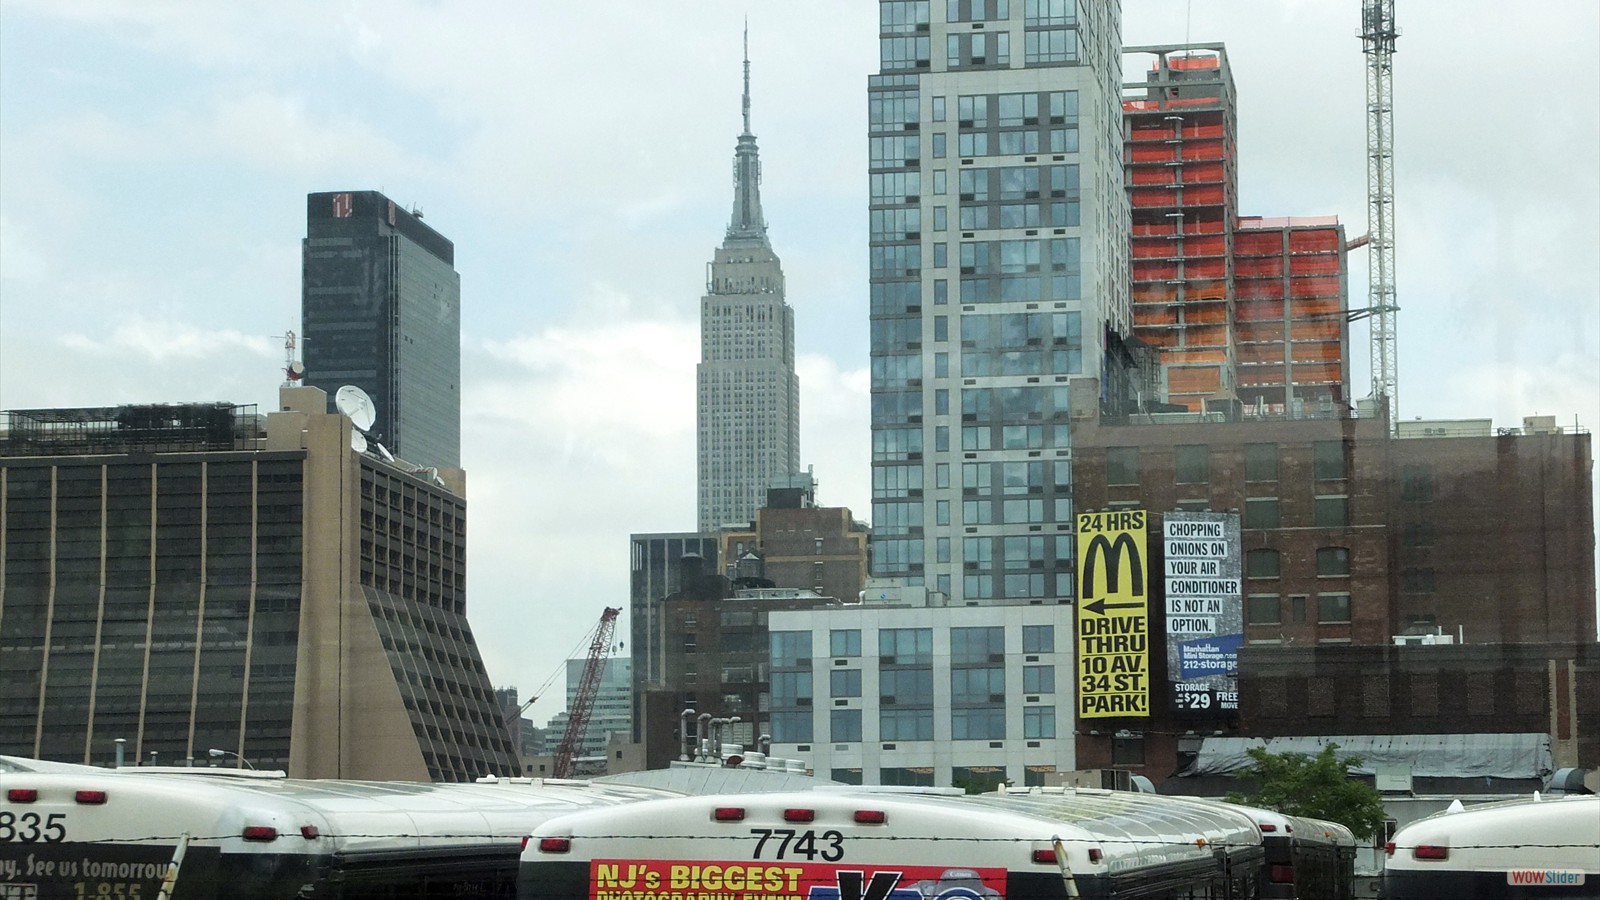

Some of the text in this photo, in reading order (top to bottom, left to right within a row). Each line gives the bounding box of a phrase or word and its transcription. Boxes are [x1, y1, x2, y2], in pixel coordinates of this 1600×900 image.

[1080, 511, 1144, 533] 24 HRS
[1169, 523, 1221, 537] CHOPPING
[1170, 542, 1225, 556] ONIONS ON
[1170, 561, 1217, 575] YOUR AIR
[1171, 580, 1238, 594] CONDITIONER
[1171, 599, 1220, 613] IS NOT AN
[1081, 616, 1146, 636] DRIVE
[1172, 618, 1212, 632] OPTION.
[1081, 634, 1146, 654] THRU
[1183, 643, 1220, 652] Manhattan
[1183, 652, 1198, 660] Mini
[1082, 655, 1146, 674] 10 AV.
[1082, 673, 1146, 693] 34 ST.
[1175, 683, 1210, 692] STORAGE
[1184, 692, 1211, 709] $29
[1216, 691, 1239, 702] FREE
[1082, 694, 1147, 714] PARK!
[1221, 701, 1239, 709] MOVE
[750, 828, 845, 862] 7743
[26, 853, 56, 877] See
[59, 861, 78, 877] us
[597, 864, 660, 889] NJ's
[669, 865, 804, 892] BIGGEST
